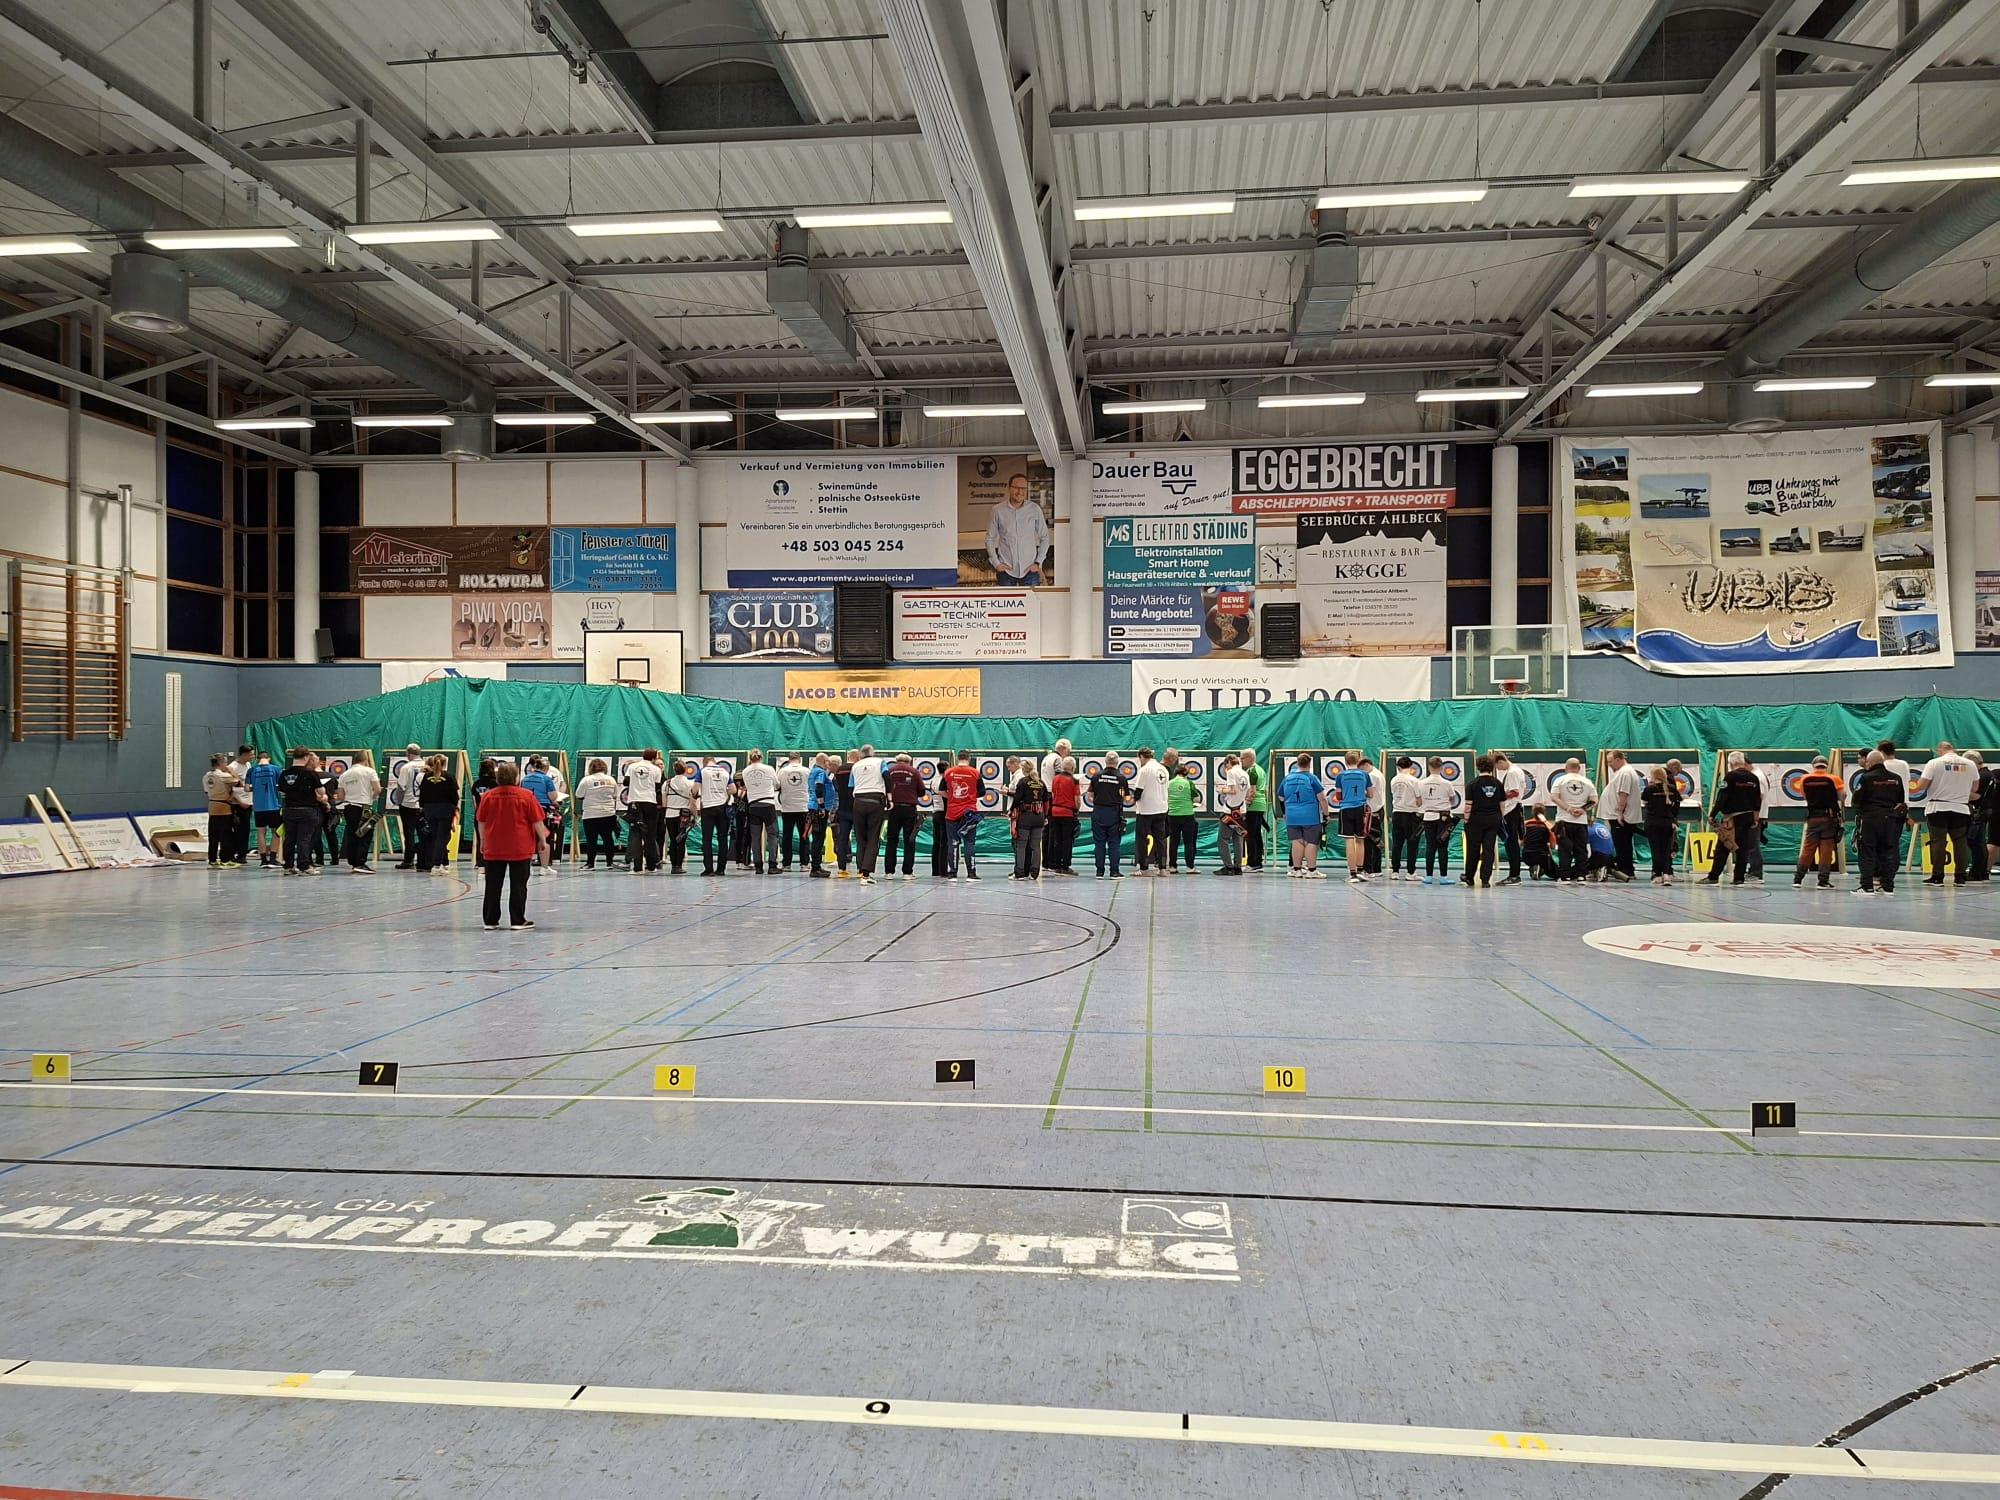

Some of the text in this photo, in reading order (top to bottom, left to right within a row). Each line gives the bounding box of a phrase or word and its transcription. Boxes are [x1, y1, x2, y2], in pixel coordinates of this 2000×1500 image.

[740, 462, 780, 471] Verkauf
[783, 462, 802, 471] und
[805, 461, 863, 472] Vermietung
[889, 460, 945, 470] Immobilien
[1239, 444, 1449, 491] EGGEBRECHT
[818, 482, 878, 491] Swinemünde
[1776, 475, 1841, 490] Unterwegs mit
[818, 493, 921, 503] polnische Ostseeküste
[1164, 488, 1231, 510] auf Dauer gut!
[1239, 496, 1354, 510] ABSCHLEPPDIENST
[1365, 494, 1448, 506] TRANSPORTE
[1777, 487, 1826, 502] Bus und
[818, 505, 848, 514] Stettin
[1779, 496, 1837, 512] Bäderbahn
[740, 520, 945, 531] Vereinbaren Sie ein unverbindliches Beratungsgespräch
[1301, 512, 1443, 527] SEEBRÜCKE AHLBECK
[1107, 518, 1248, 546] MS ELEKTRO STÄDING
[581, 530, 623, 551] Fenster
[625, 537, 634, 547] &
[782, 540, 904, 552] +48 503 045 254
[365, 541, 441, 566] Meiering
[581, 553, 618, 562] Heringsdorf
[618, 553, 638, 561] GmbH
[658, 553, 669, 561] KG
[1135, 547, 1223, 557] Elektroinstallation
[1322, 547, 1421, 559] RESTAURANT & BAR
[1148, 558, 1210, 568] Smart Home
[459, 573, 545, 589] HOLZWURM
[1107, 568, 1251, 581] Hausgeräteservice & -verkauf
[766, 593, 801, 601] Wirtschaft
[1685, 567, 1835, 614] UBB
[591, 601, 615, 610] HGV
[1111, 594, 1192, 605] Deine Märkte für
[1222, 596, 1245, 604] REWE
[461, 602, 544, 623] PIWI YOGA
[727, 602, 819, 628] CLUB
[942, 611, 987, 620] TECHNIK
[1110, 607, 1193, 621] bunte Angebote!
[966, 621, 1001, 629] SCHULTZ
[748, 629, 800, 651] 100
[902, 632, 937, 640] FRANKE
[992, 632, 1026, 640] PALUX
[717, 640, 730, 649] HSV
[1152, 677, 1249, 686] Sport und Wirtschaft
[788, 688, 836, 700] JACOB
[908, 685, 979, 698] BAUSTOFFE
[46, 1057, 55, 1074] 6
[950, 1062, 961, 1080] 9
[374, 1064, 385, 1083] 7
[669, 1068, 680, 1086] 8
[1275, 1070, 1293, 1087] 10
[1766, 1105, 1781, 1125] 11
[333, 1198, 436, 1214] GbR
